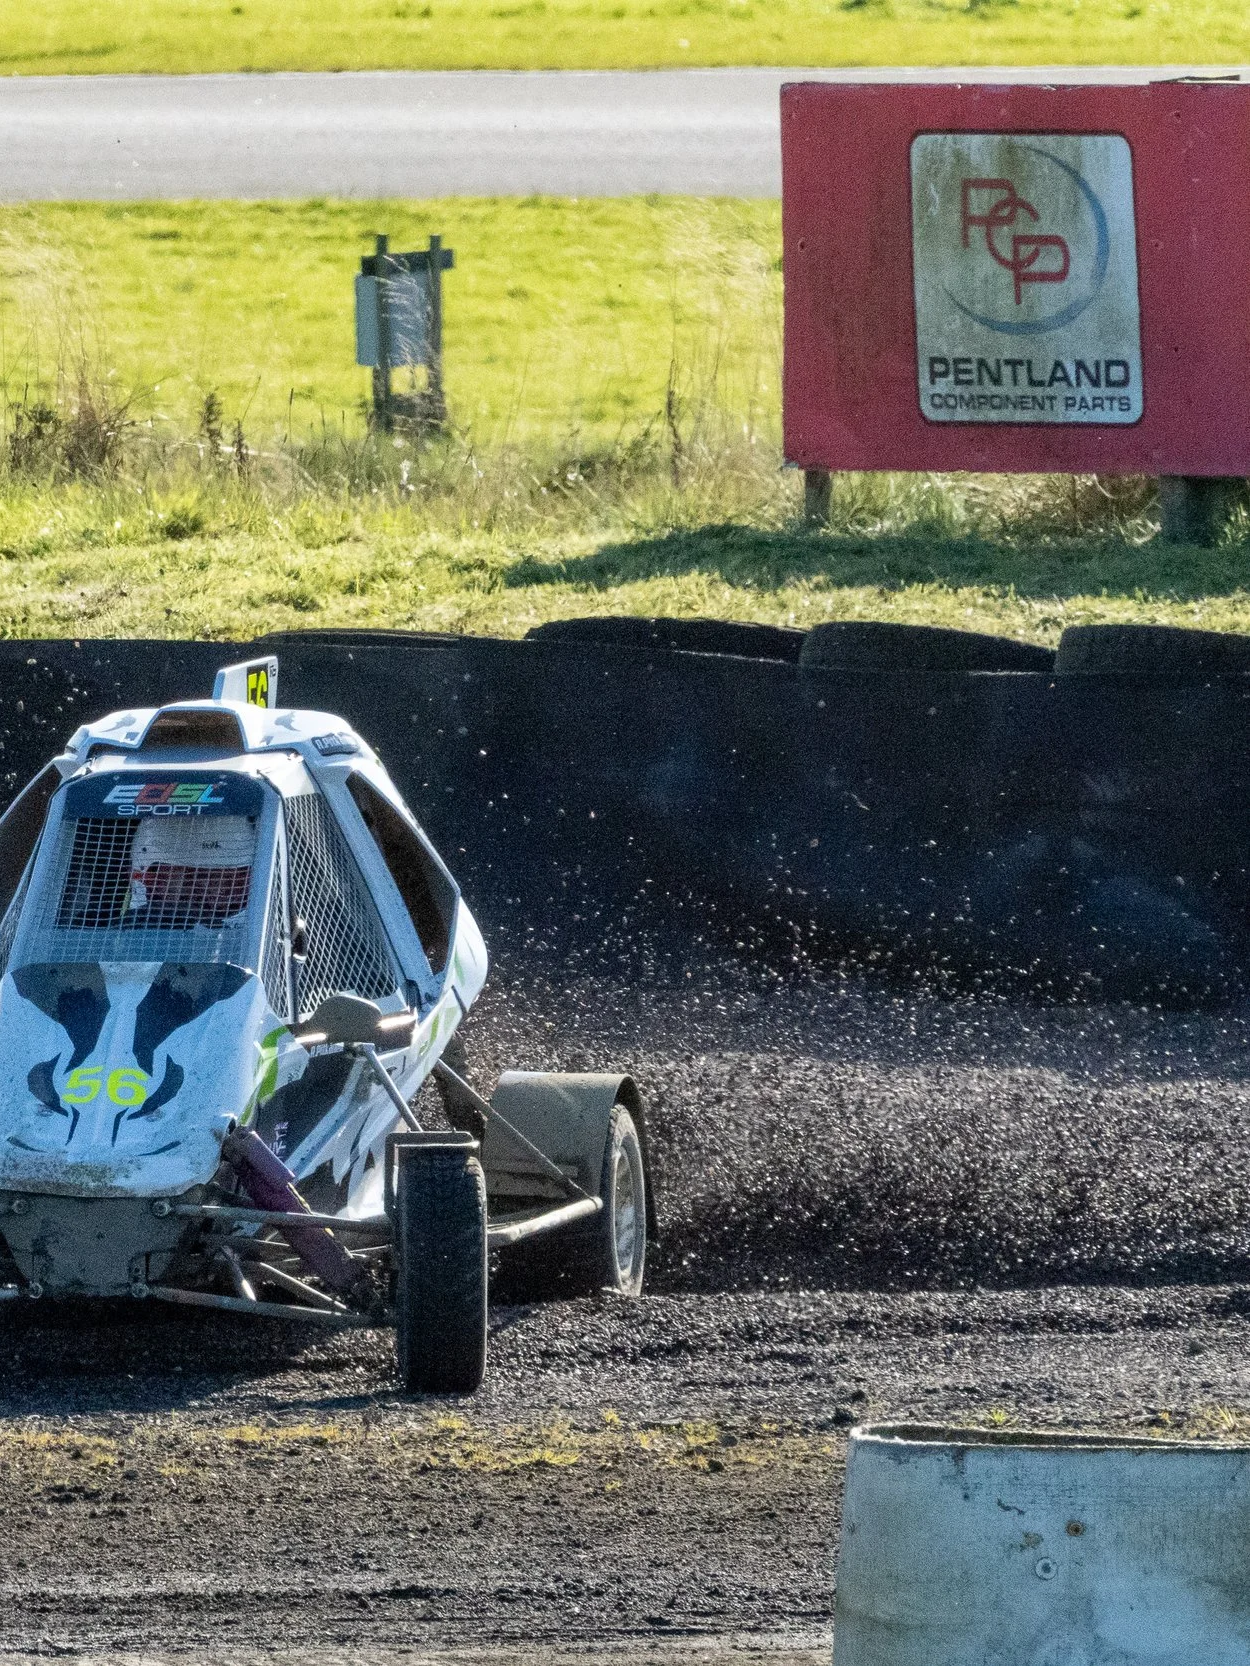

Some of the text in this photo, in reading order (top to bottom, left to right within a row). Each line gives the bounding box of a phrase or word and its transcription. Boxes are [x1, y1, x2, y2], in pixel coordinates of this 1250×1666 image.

[929, 357, 1130, 388] PENTLAND
[930, 393, 1131, 412] COMPONENT PARTS
[248, 670, 267, 708] 56
[117, 804, 209, 816] SPORT
[61, 1065, 148, 1106] 56
